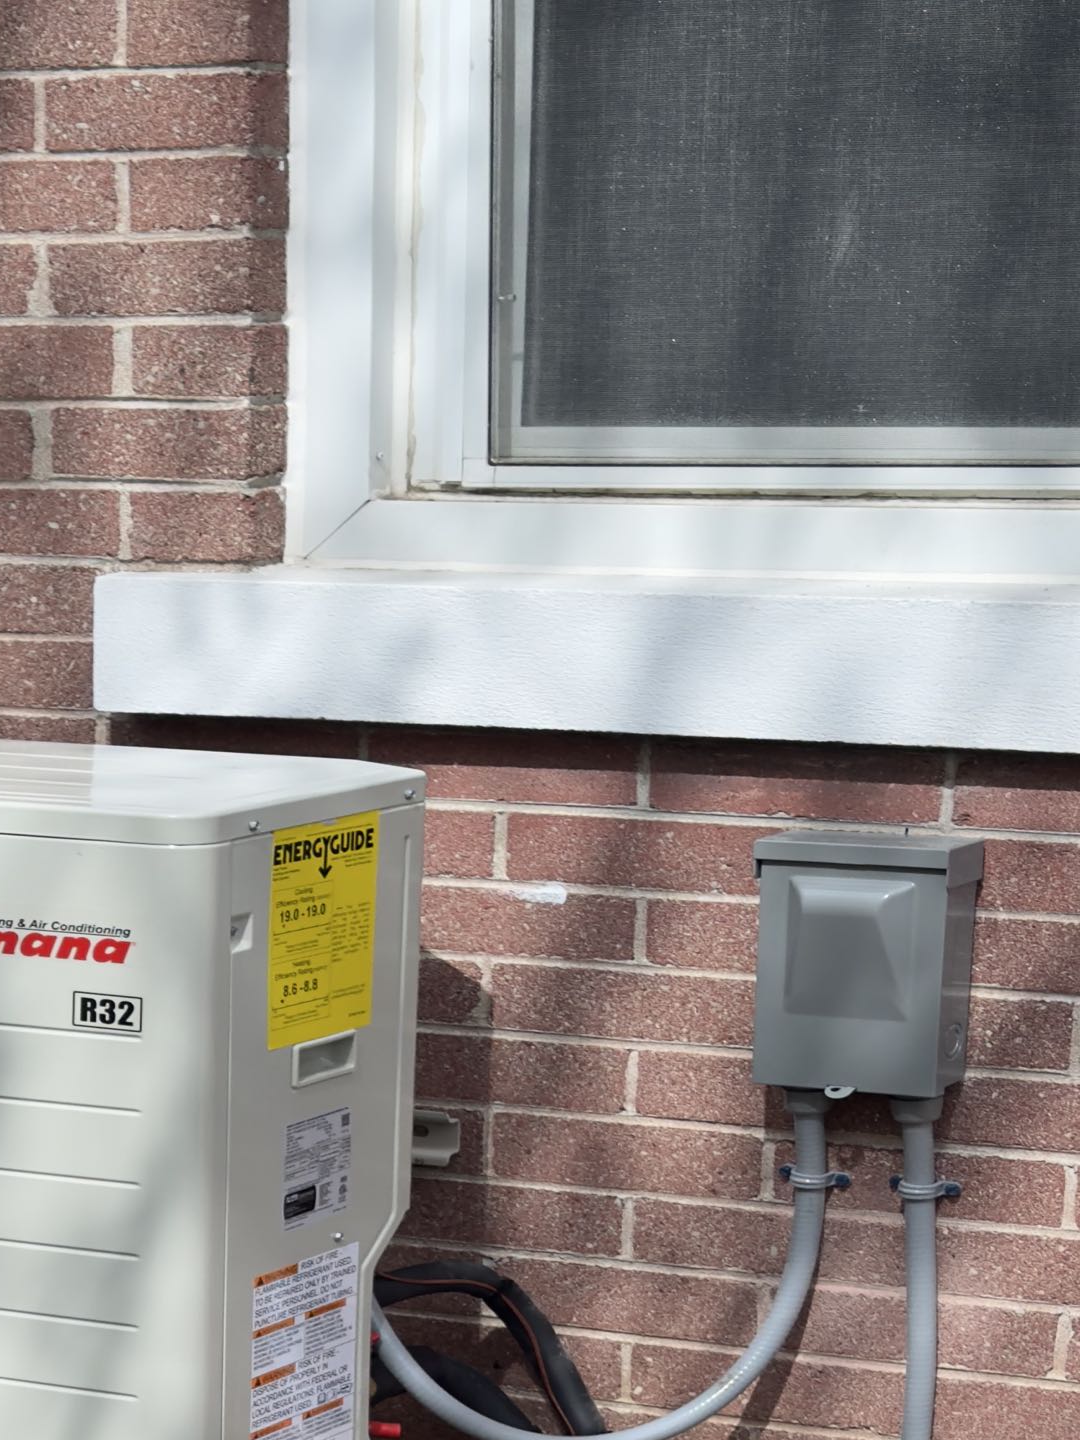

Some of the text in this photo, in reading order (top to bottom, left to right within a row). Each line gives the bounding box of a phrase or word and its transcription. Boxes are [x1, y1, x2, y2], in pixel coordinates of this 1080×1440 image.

[273, 828, 374, 866] ENERGYGUIDE
[280, 908, 299, 923] 19.0
[306, 903, 326, 918] 19.0
[17, 919, 26, 928] &
[30, 919, 47, 929] Air
[51, 921, 131, 938] Conditioning
[283, 985, 297, 997] 8.6
[80, 997, 135, 1027] R32
[301, 1259, 314, 1269] RISK
[255, 1278, 291, 1296] FLAMMABLE
[292, 1262, 334, 1282] REFRIGERANT
[305, 1278, 320, 1289] ONLY
